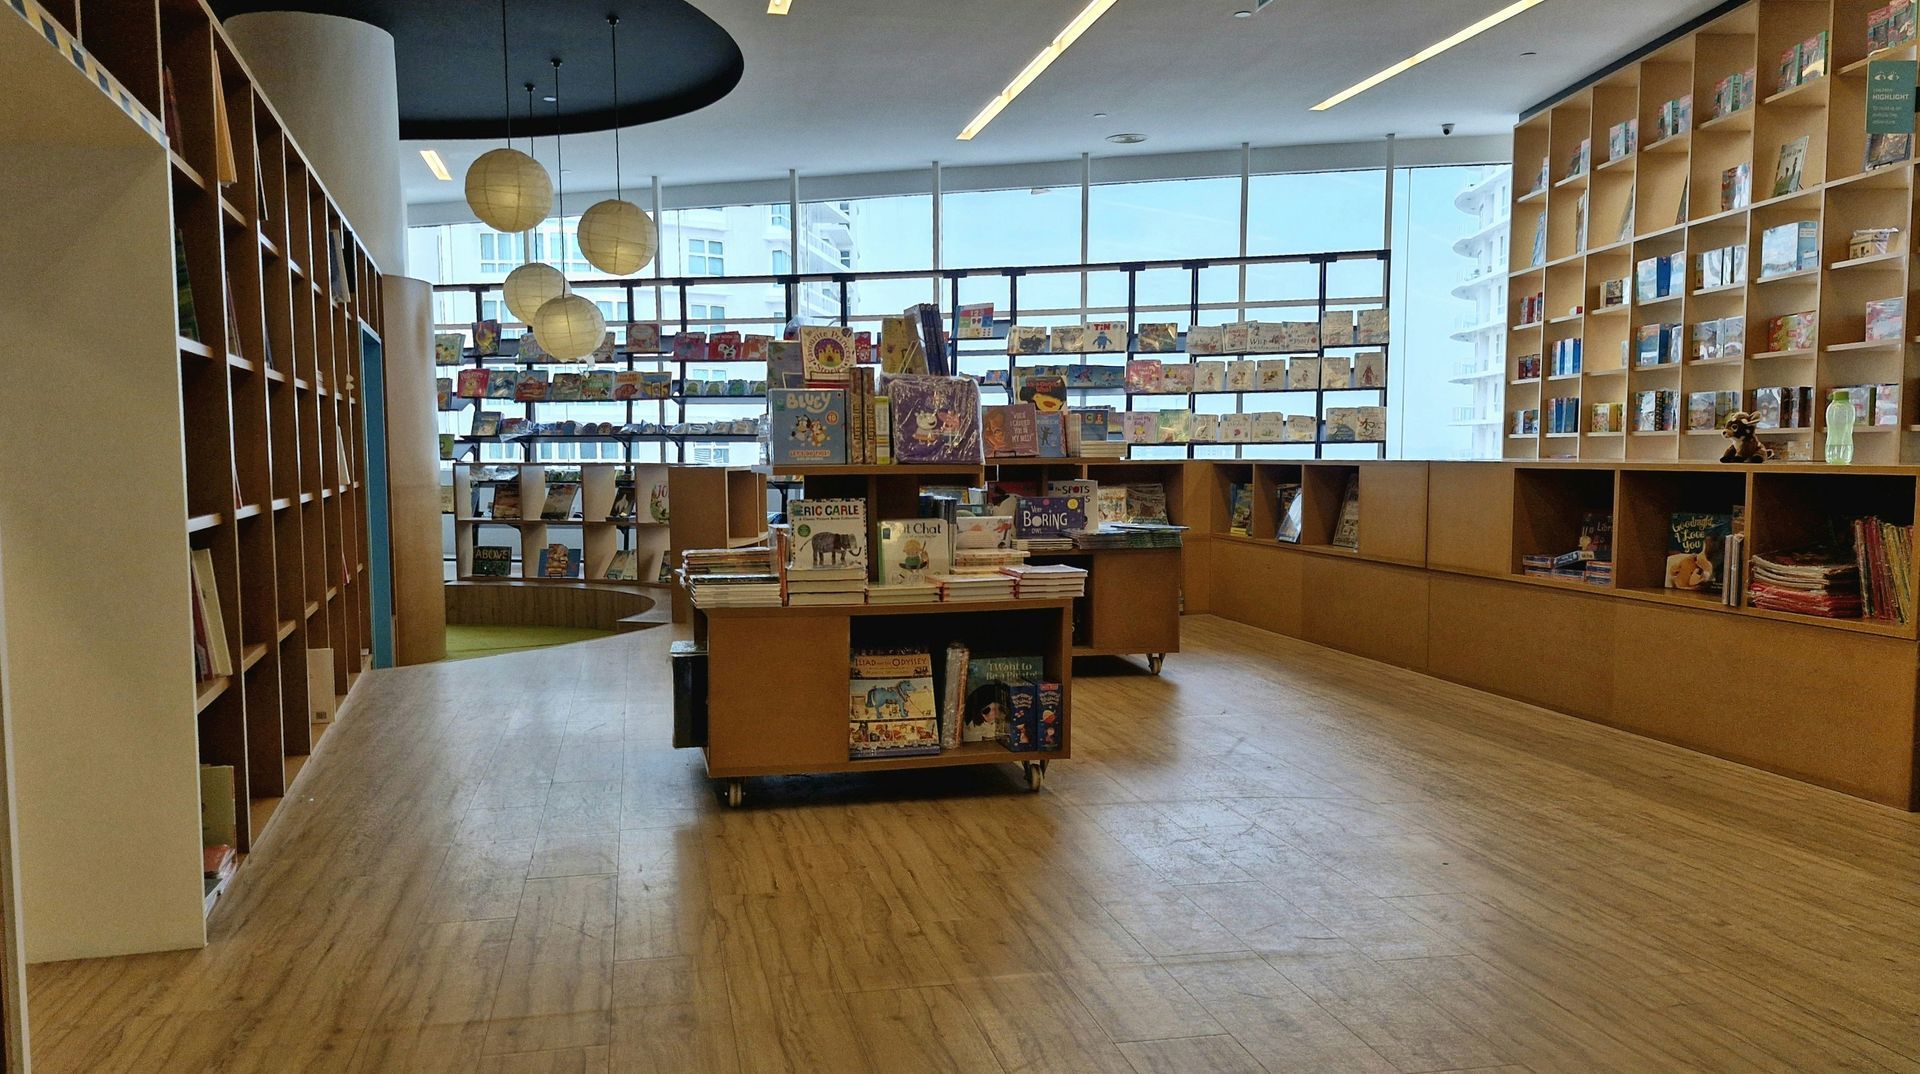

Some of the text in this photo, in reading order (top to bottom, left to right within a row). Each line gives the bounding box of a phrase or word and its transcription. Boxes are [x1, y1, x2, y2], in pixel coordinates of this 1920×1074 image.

[1062, 486, 1090, 494] SPOTS
[825, 505, 859, 516] CARLE
[1023, 511, 1068, 530] BORING
[913, 523, 942, 534] Chat
[855, 659, 876, 667] ILIAD
[892, 657, 927, 667] ODYSSEY
[1022, 663, 1032, 671] to
